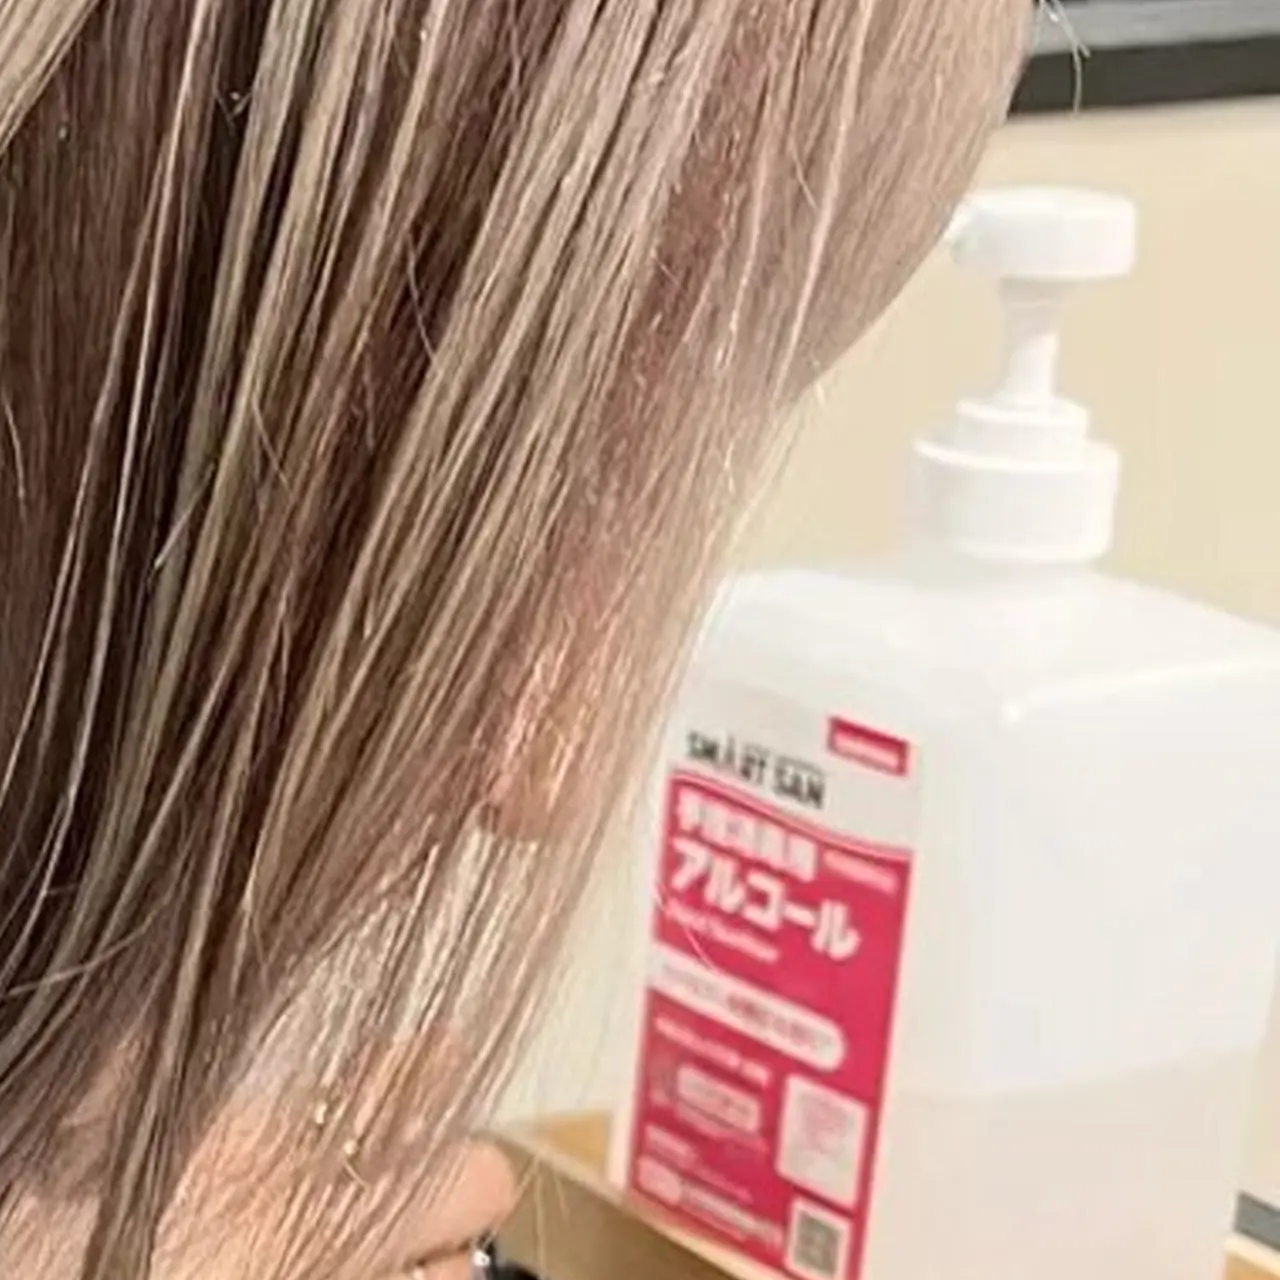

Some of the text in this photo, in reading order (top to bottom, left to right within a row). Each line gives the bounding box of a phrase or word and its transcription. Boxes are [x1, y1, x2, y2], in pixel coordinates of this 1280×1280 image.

[773, 757, 825, 808] SAN
[671, 837, 861, 960] アルコール
